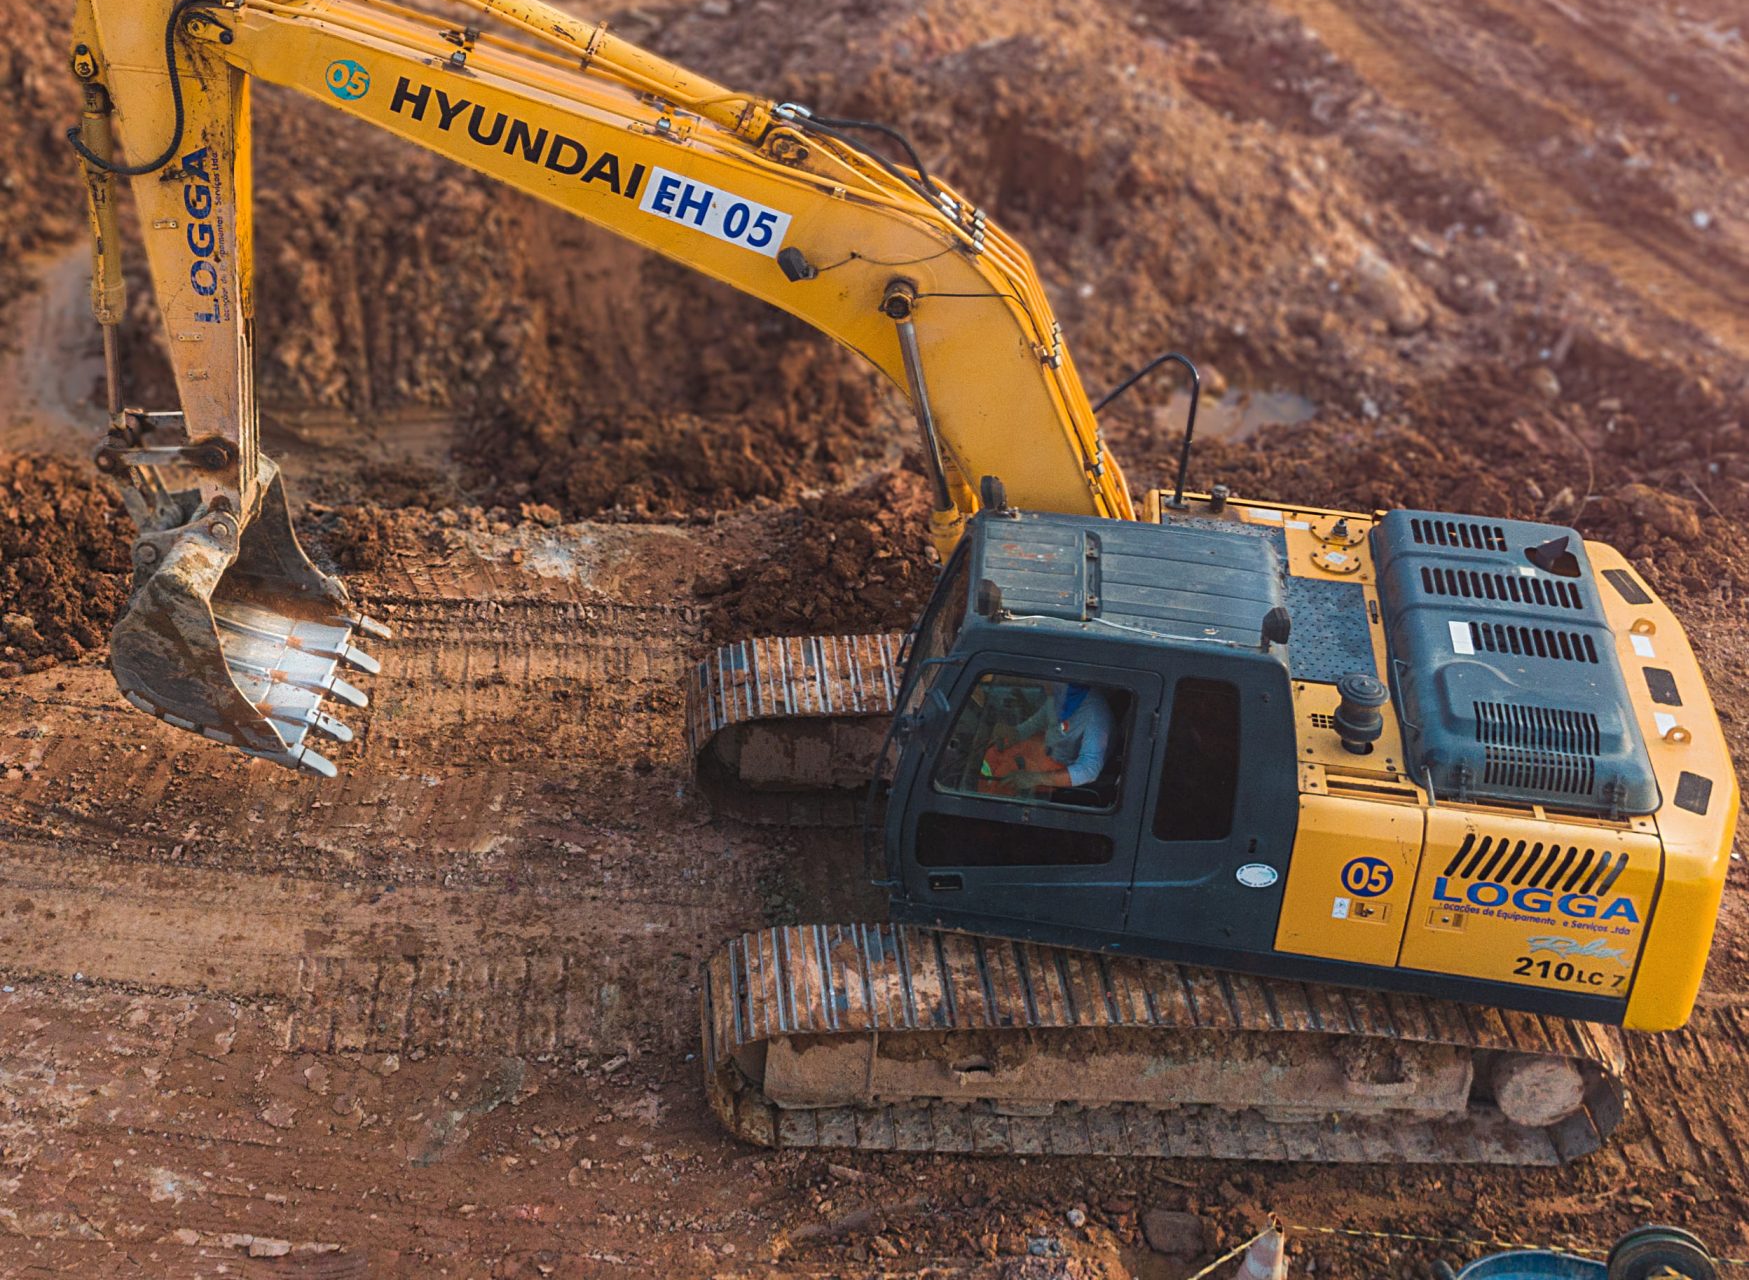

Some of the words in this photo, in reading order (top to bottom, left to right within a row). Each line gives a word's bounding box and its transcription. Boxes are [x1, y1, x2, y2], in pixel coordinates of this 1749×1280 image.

[327, 61, 369, 96] 05
[390, 76, 645, 200] HYUNDAI
[651, 174, 715, 227] EH
[723, 202, 778, 248] 05
[181, 147, 220, 324] LOGGA
[1346, 861, 1389, 893] 05
[1432, 876, 1640, 923] LOGGA
[1440, 903, 1480, 915] ocações
[1482, 907, 1494, 916] de
[1571, 920, 1608, 934] Serviços
